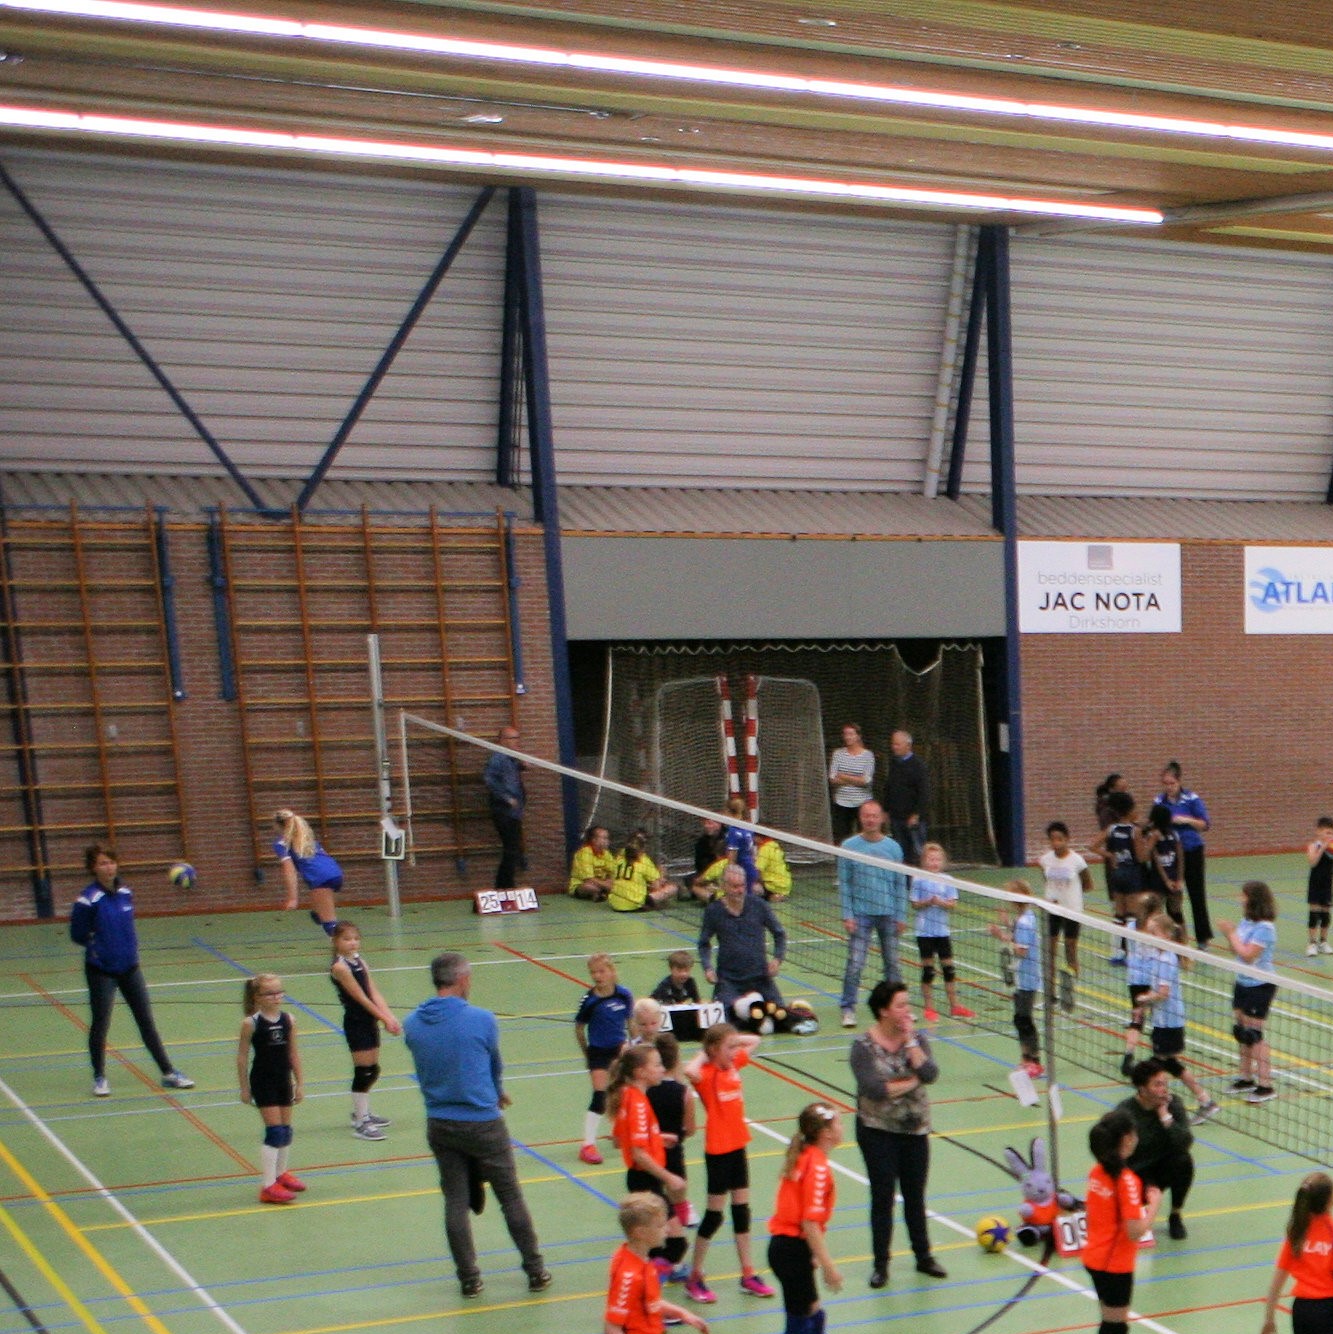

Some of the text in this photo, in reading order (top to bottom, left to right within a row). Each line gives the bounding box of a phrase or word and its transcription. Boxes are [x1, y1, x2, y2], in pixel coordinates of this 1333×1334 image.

[1037, 572, 1163, 586] beddenspecialist
[1038, 592, 1161, 611] JAC NOTA
[1068, 616, 1141, 629] Dirkshorn
[616, 863, 634, 880] 10
[481, 894, 499, 910] 25
[519, 892, 537, 908] 14
